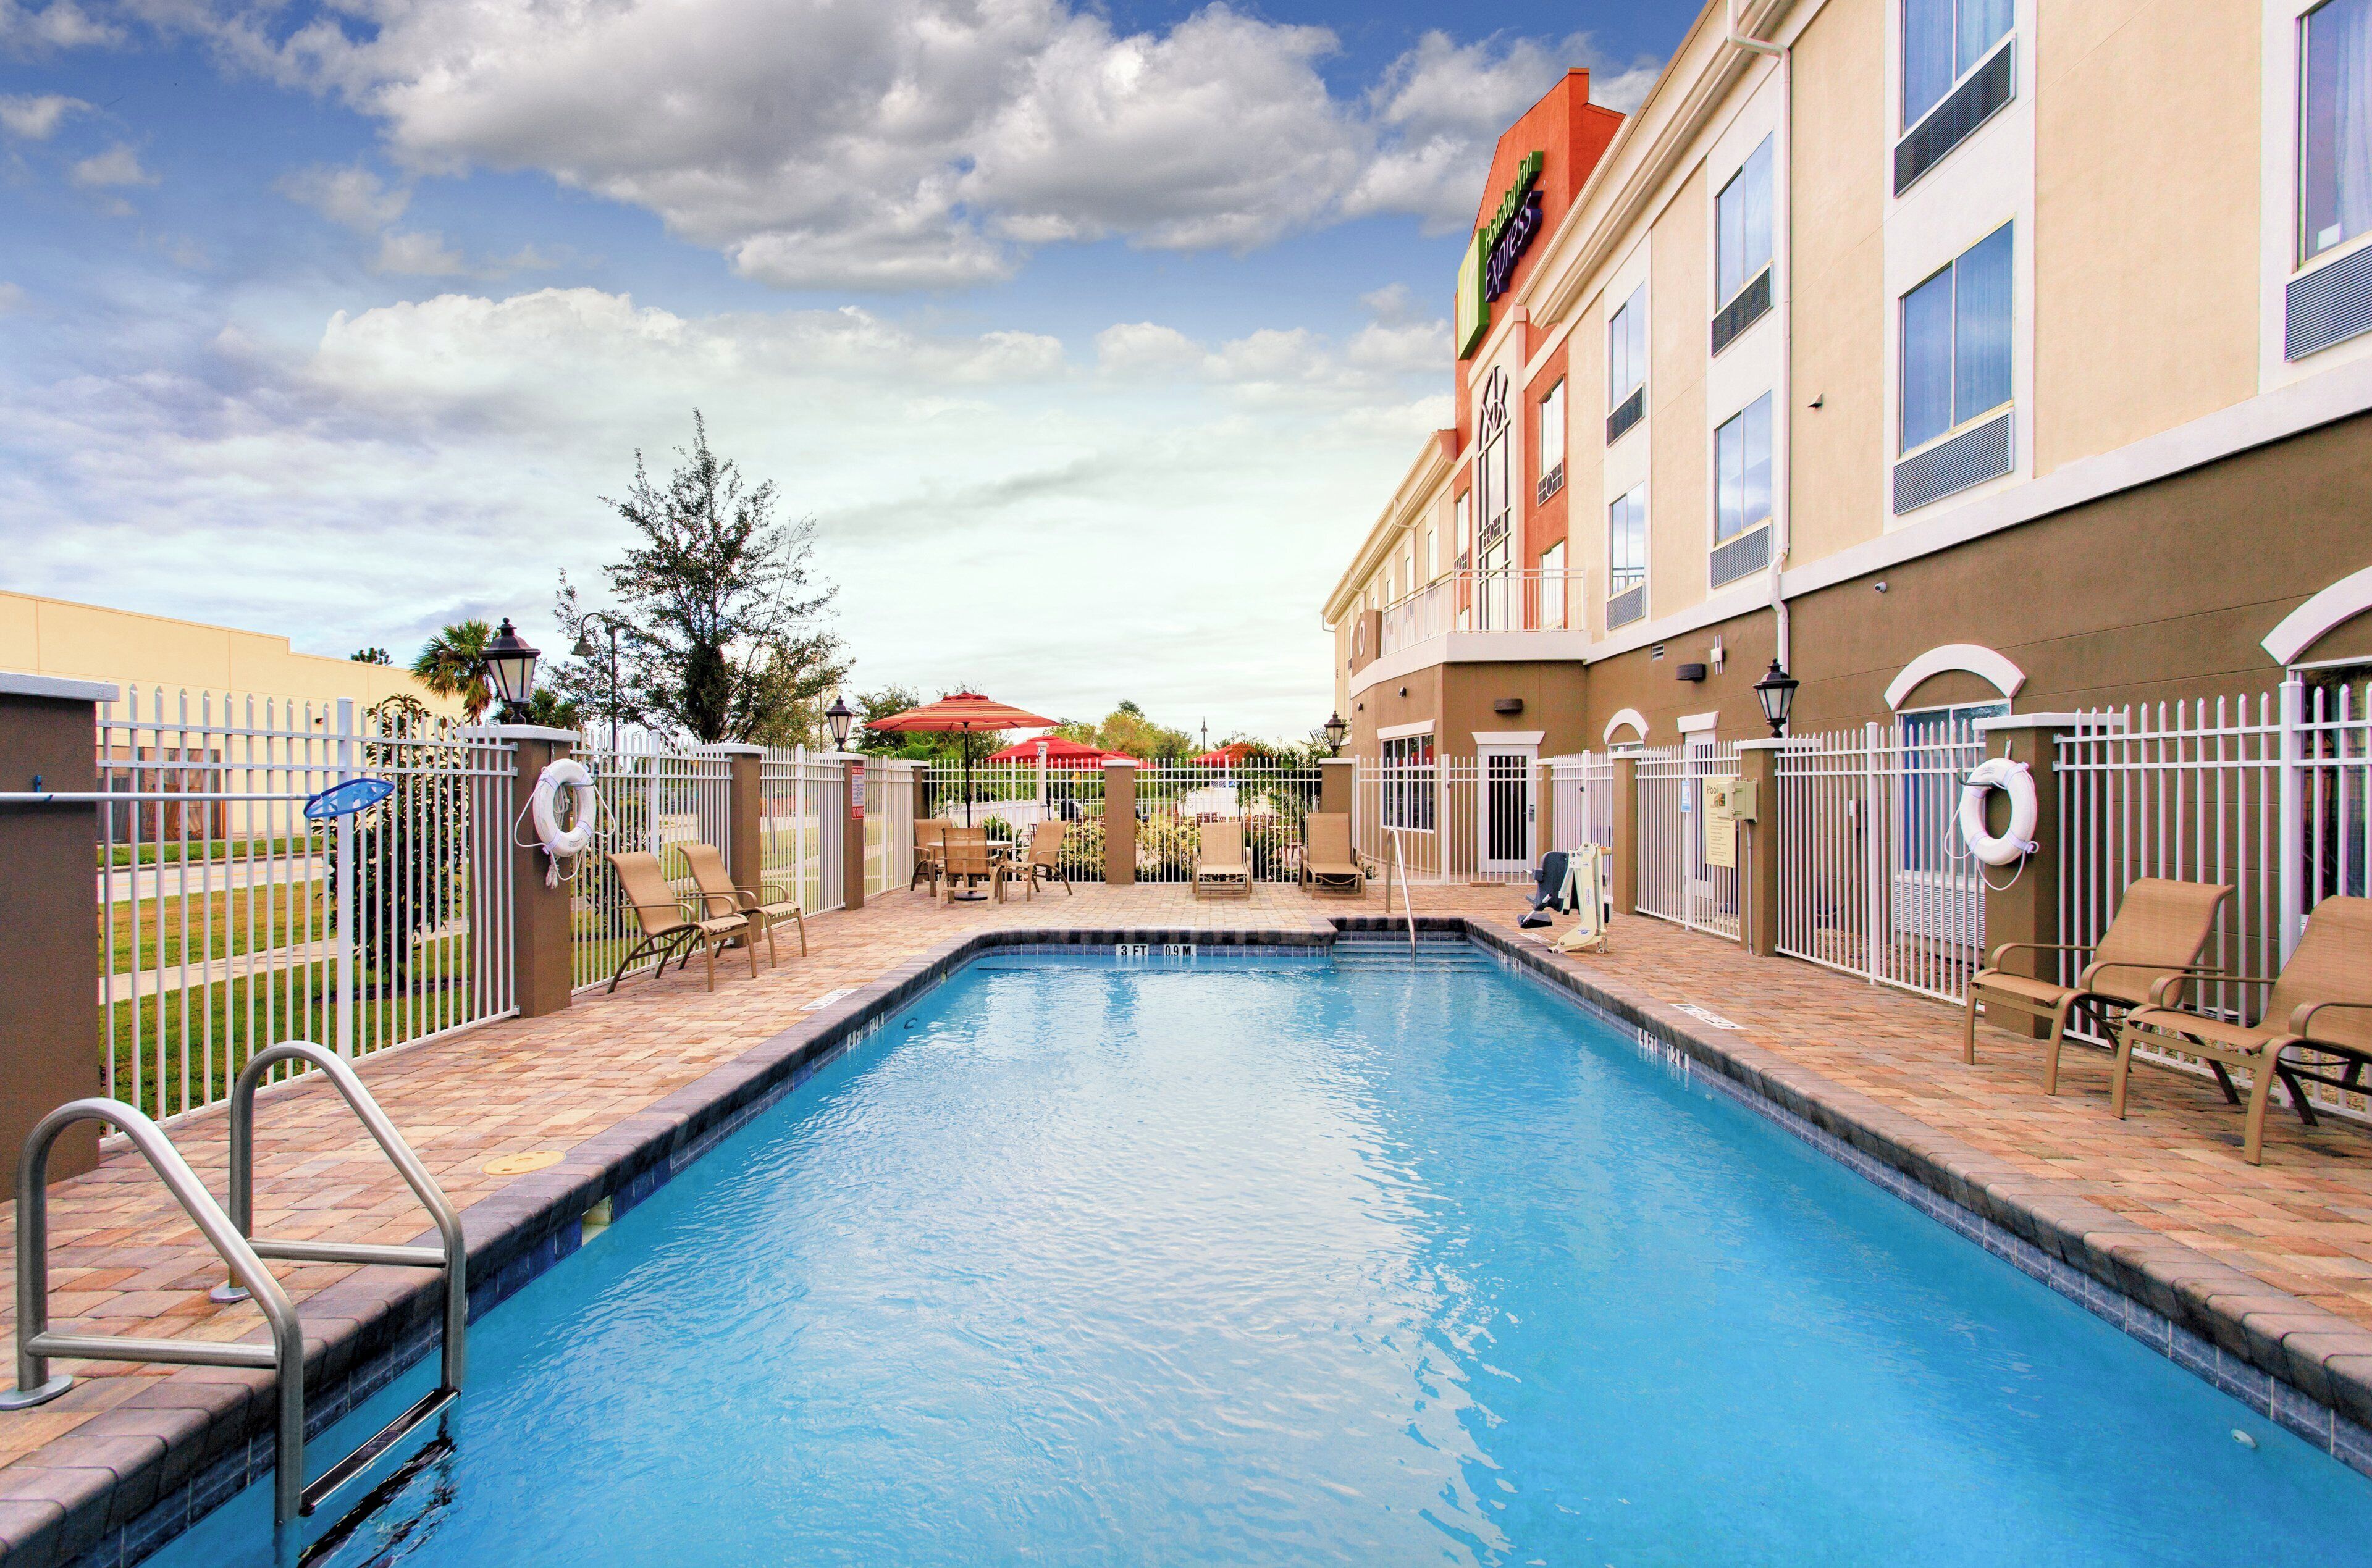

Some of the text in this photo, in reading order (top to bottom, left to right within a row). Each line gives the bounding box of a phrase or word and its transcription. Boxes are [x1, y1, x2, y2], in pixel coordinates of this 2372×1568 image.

[1485, 151, 1533, 257] Holiday Inn
[1485, 190, 1533, 303] Express
[1707, 785, 1718, 794] Pool
[1121, 945, 1147, 956] 3 FT.
[1165, 945, 1194, 956] 0.9 M.
[1640, 1029, 1656, 1053] 4 FT.
[1667, 1044, 1688, 1071] 1.2 M.
